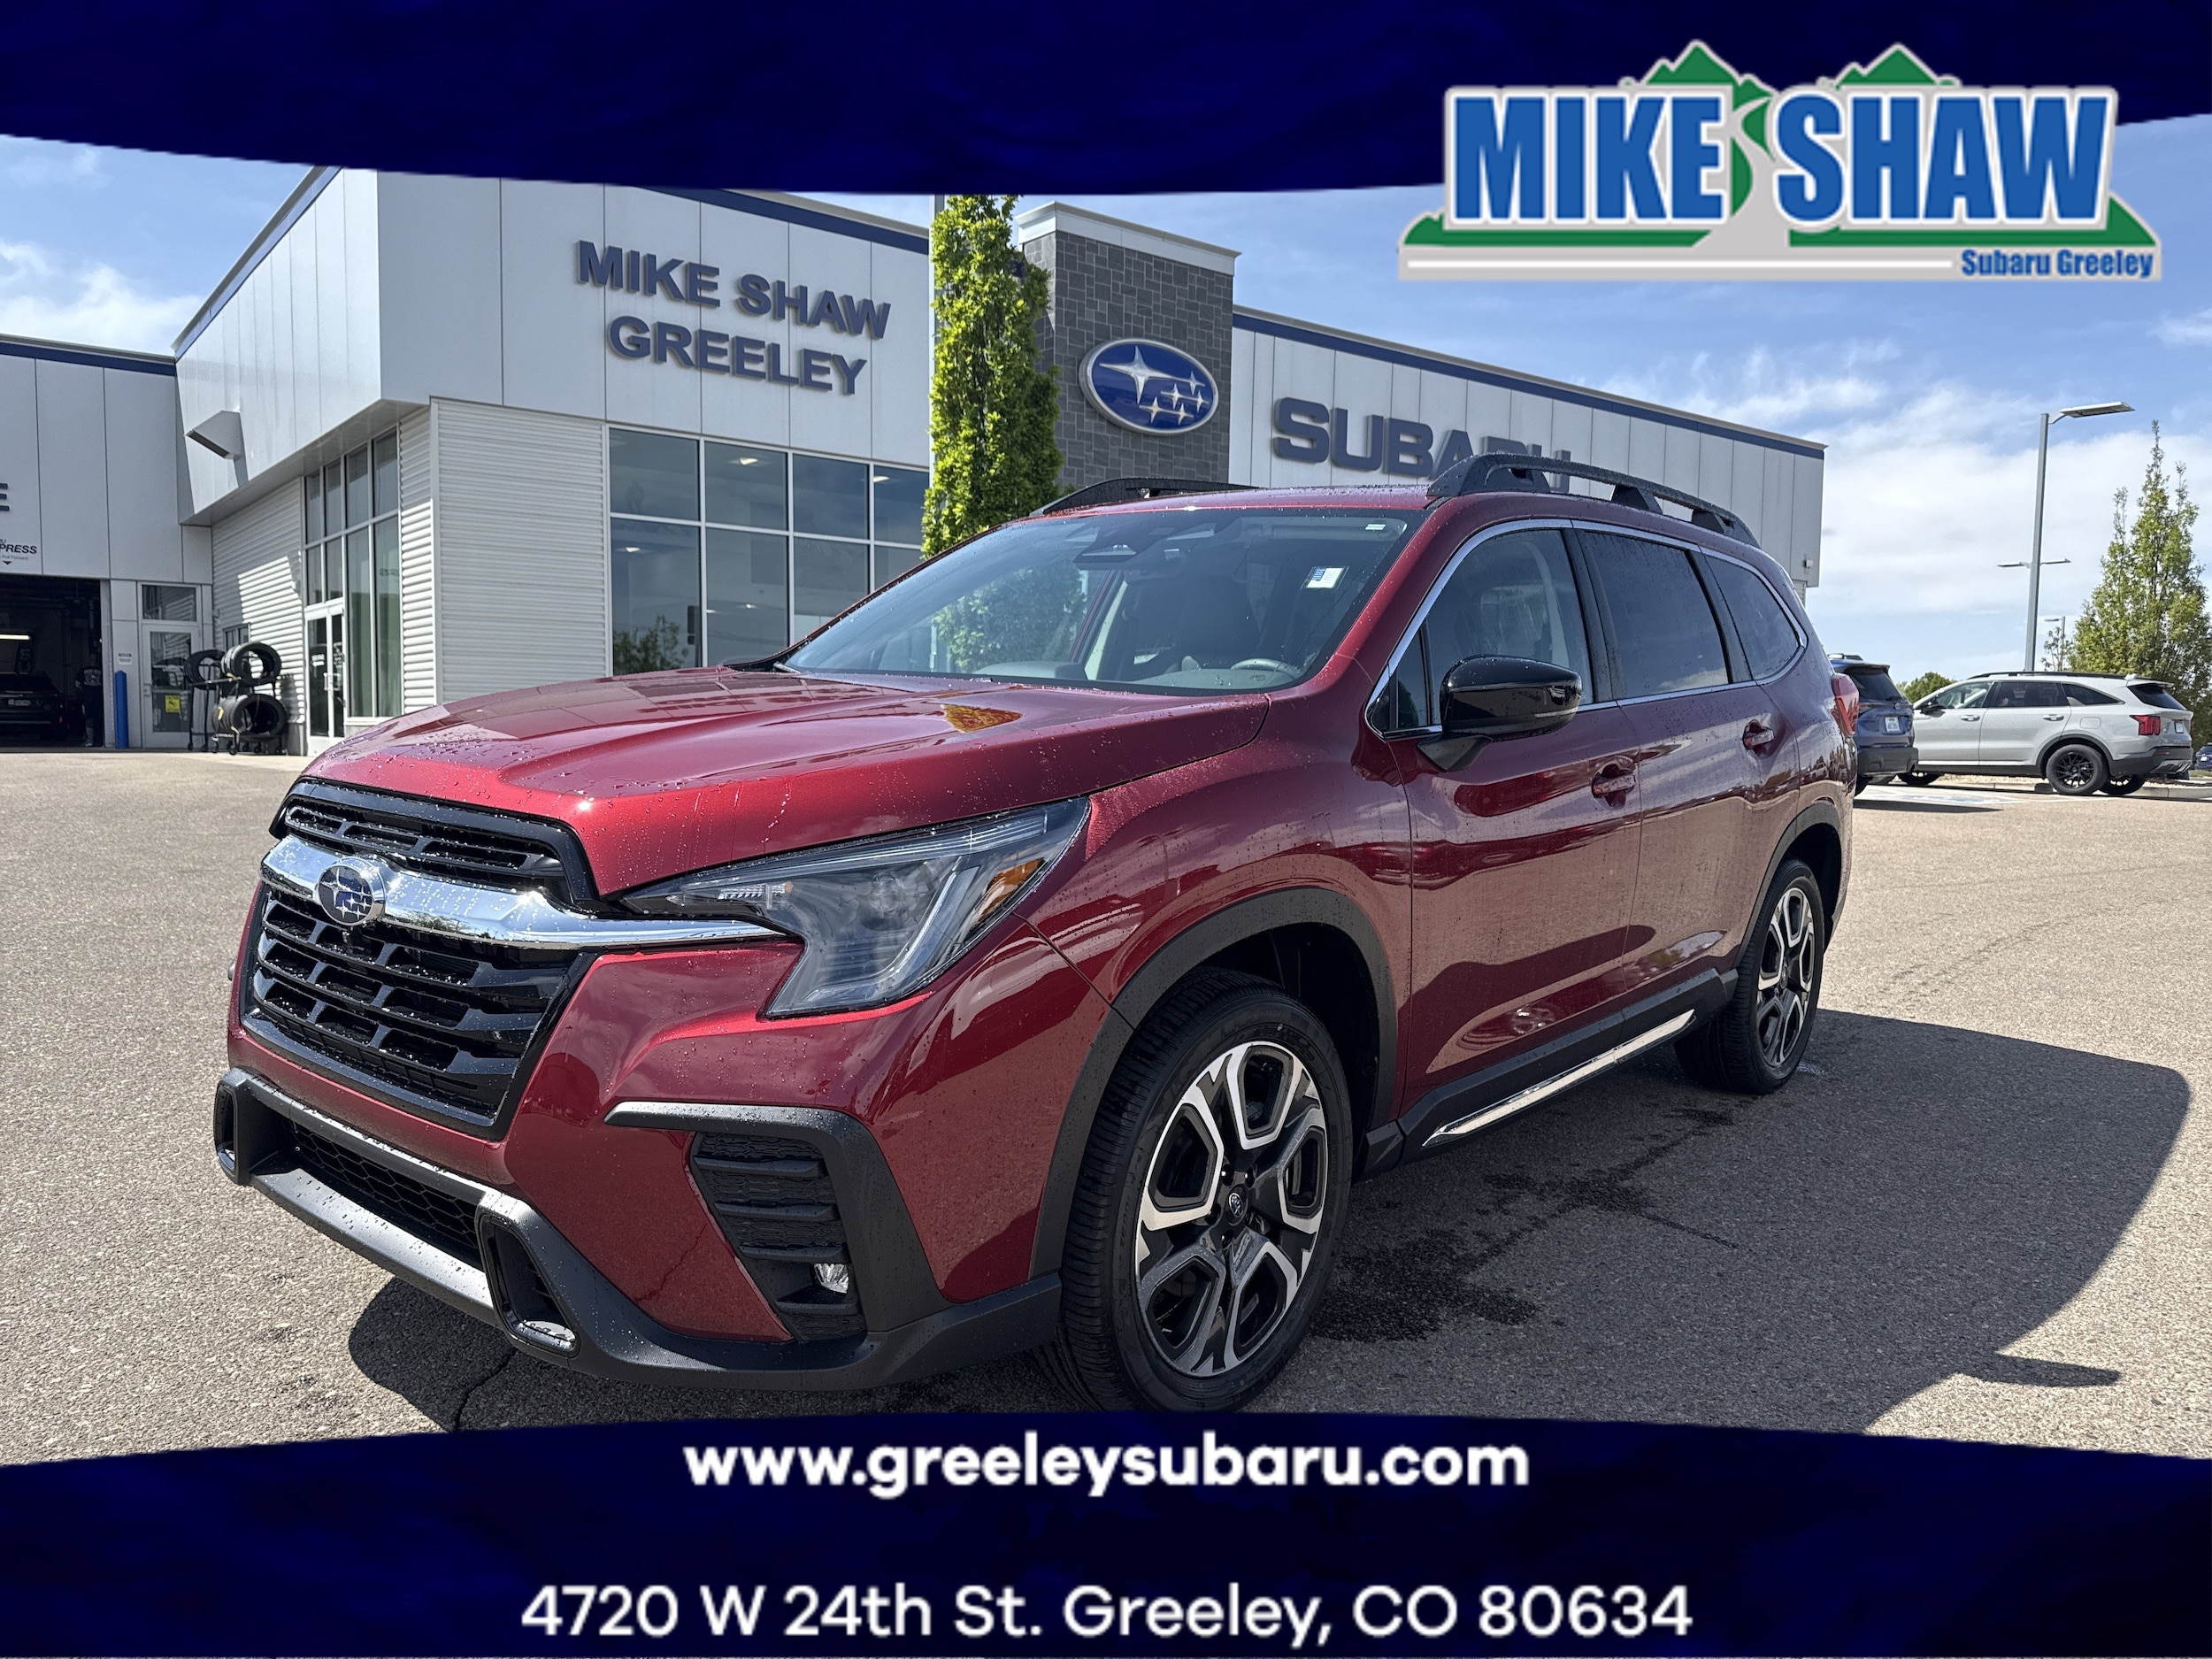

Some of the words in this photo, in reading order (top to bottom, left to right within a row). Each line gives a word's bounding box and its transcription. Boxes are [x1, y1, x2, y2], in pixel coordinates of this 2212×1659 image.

[576, 240, 720, 307] MIKE
[738, 274, 891, 339] SHAW
[609, 316, 867, 395] GREELEY
